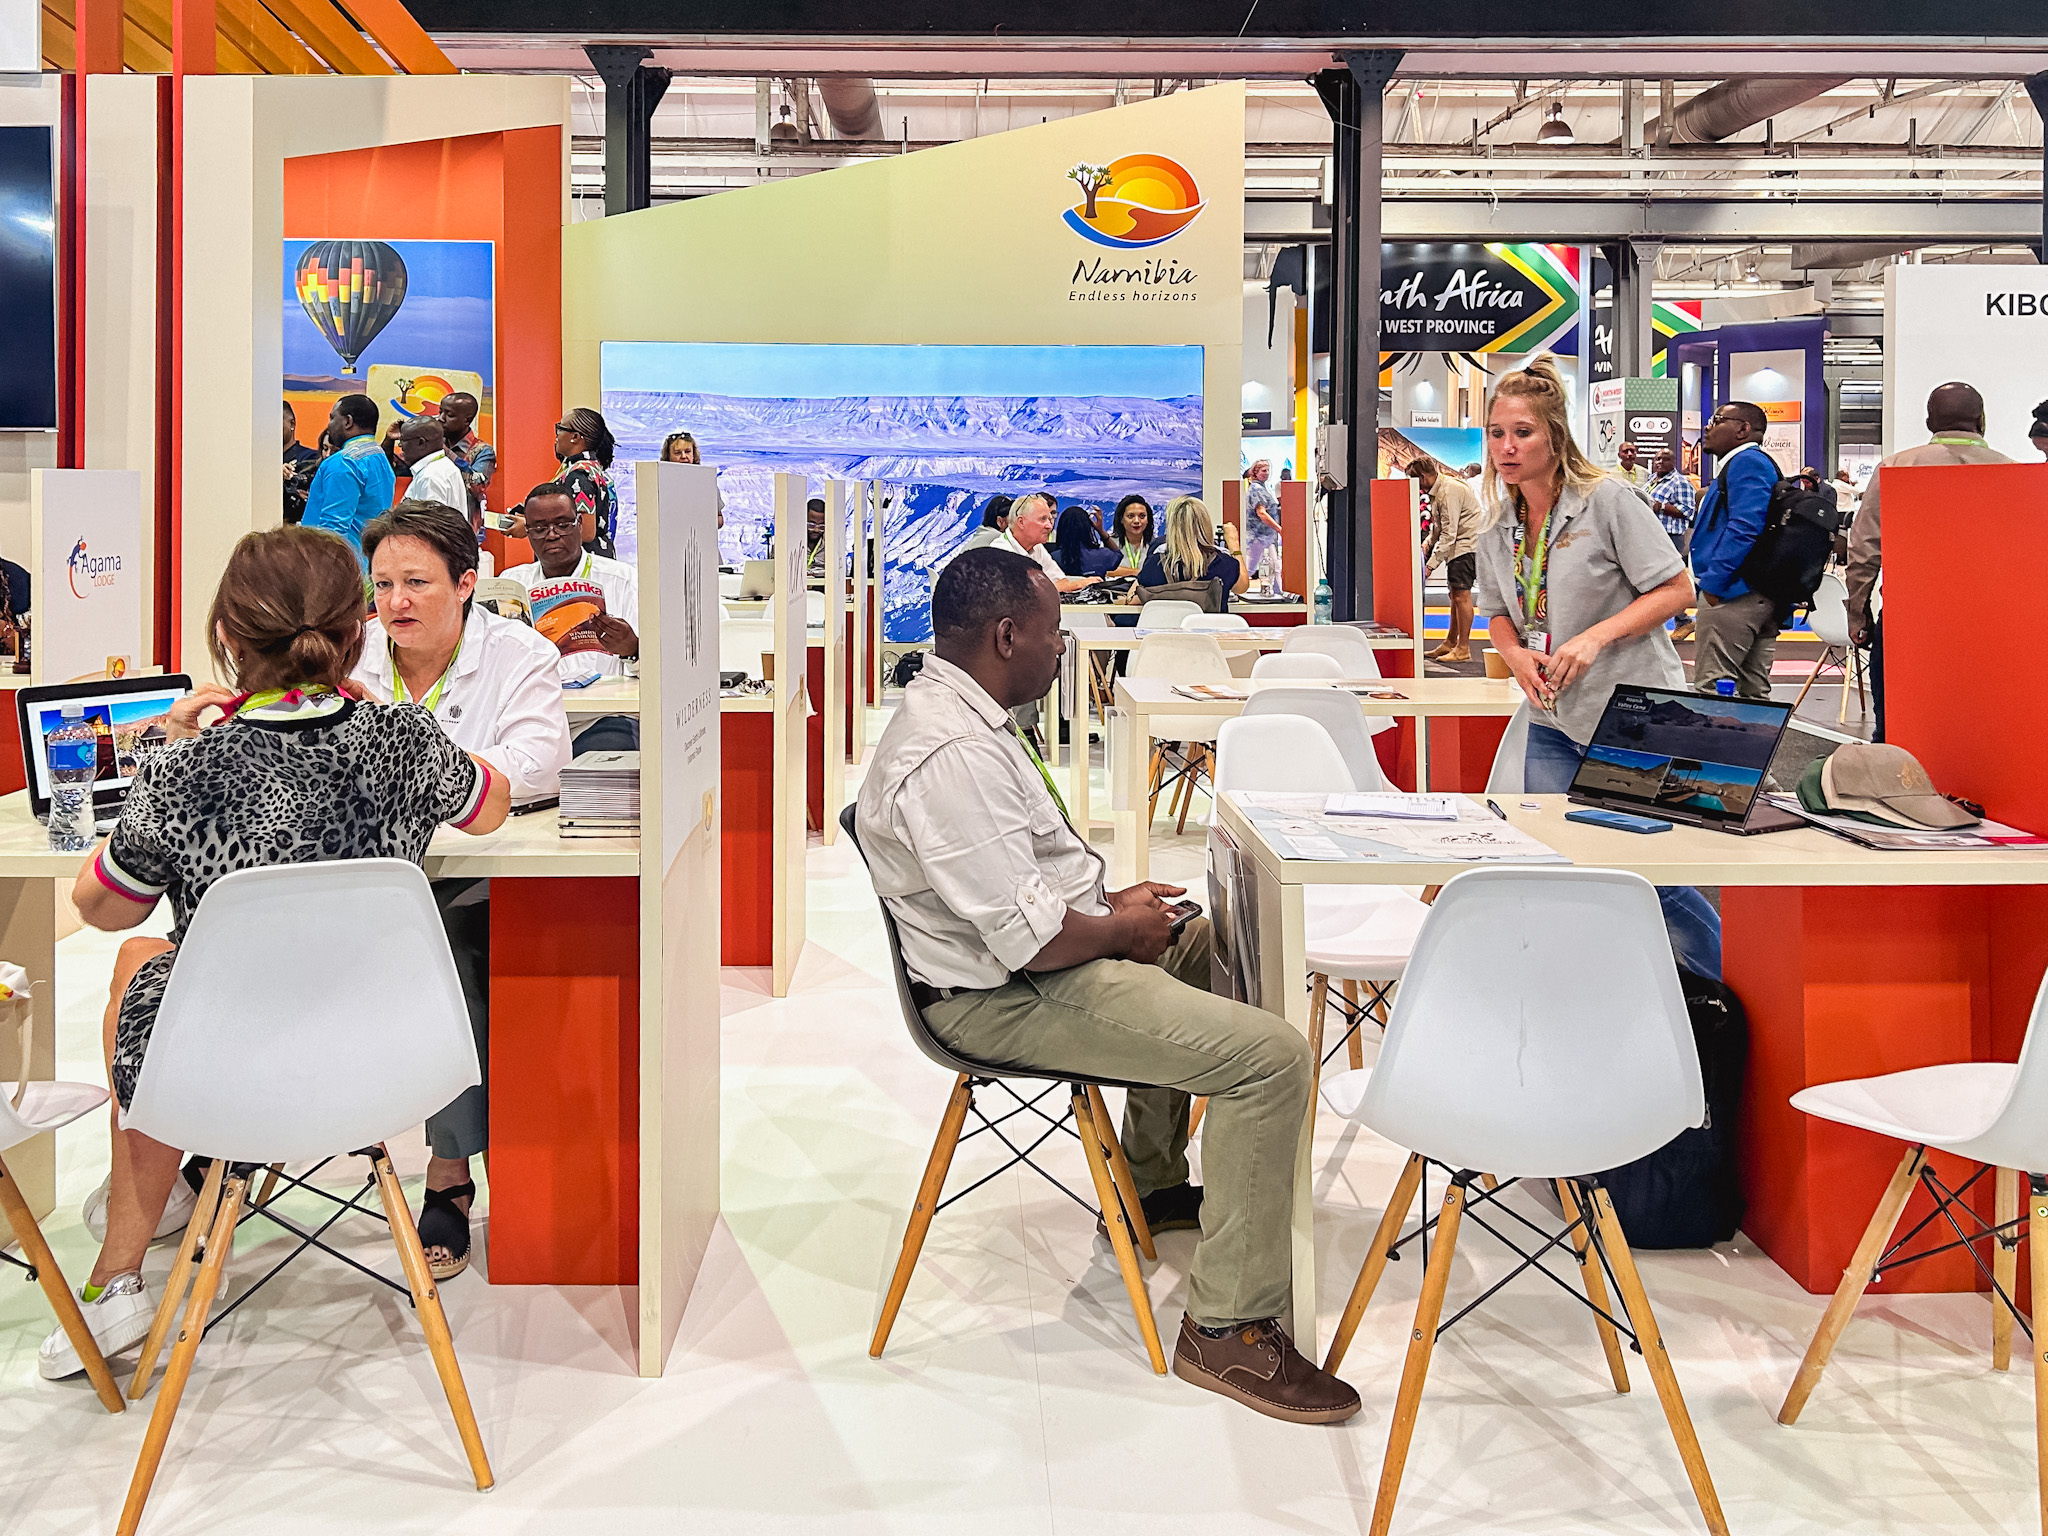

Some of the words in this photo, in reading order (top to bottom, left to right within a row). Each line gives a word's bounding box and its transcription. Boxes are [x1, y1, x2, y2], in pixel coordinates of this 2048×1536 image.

[1072, 256, 1198, 285] Namibia
[1069, 290, 1126, 301] Endless
[1132, 290, 1197, 301] horizons
[1433, 268, 1524, 312] Africa
[1384, 319, 1424, 334] WEST
[1426, 319, 1496, 335] PROVINCE
[81, 552, 121, 579] Agama
[94, 574, 115, 587] LODGE
[530, 581, 603, 602] Süd-Afrika
[675, 687, 712, 731] WILDERNESS
